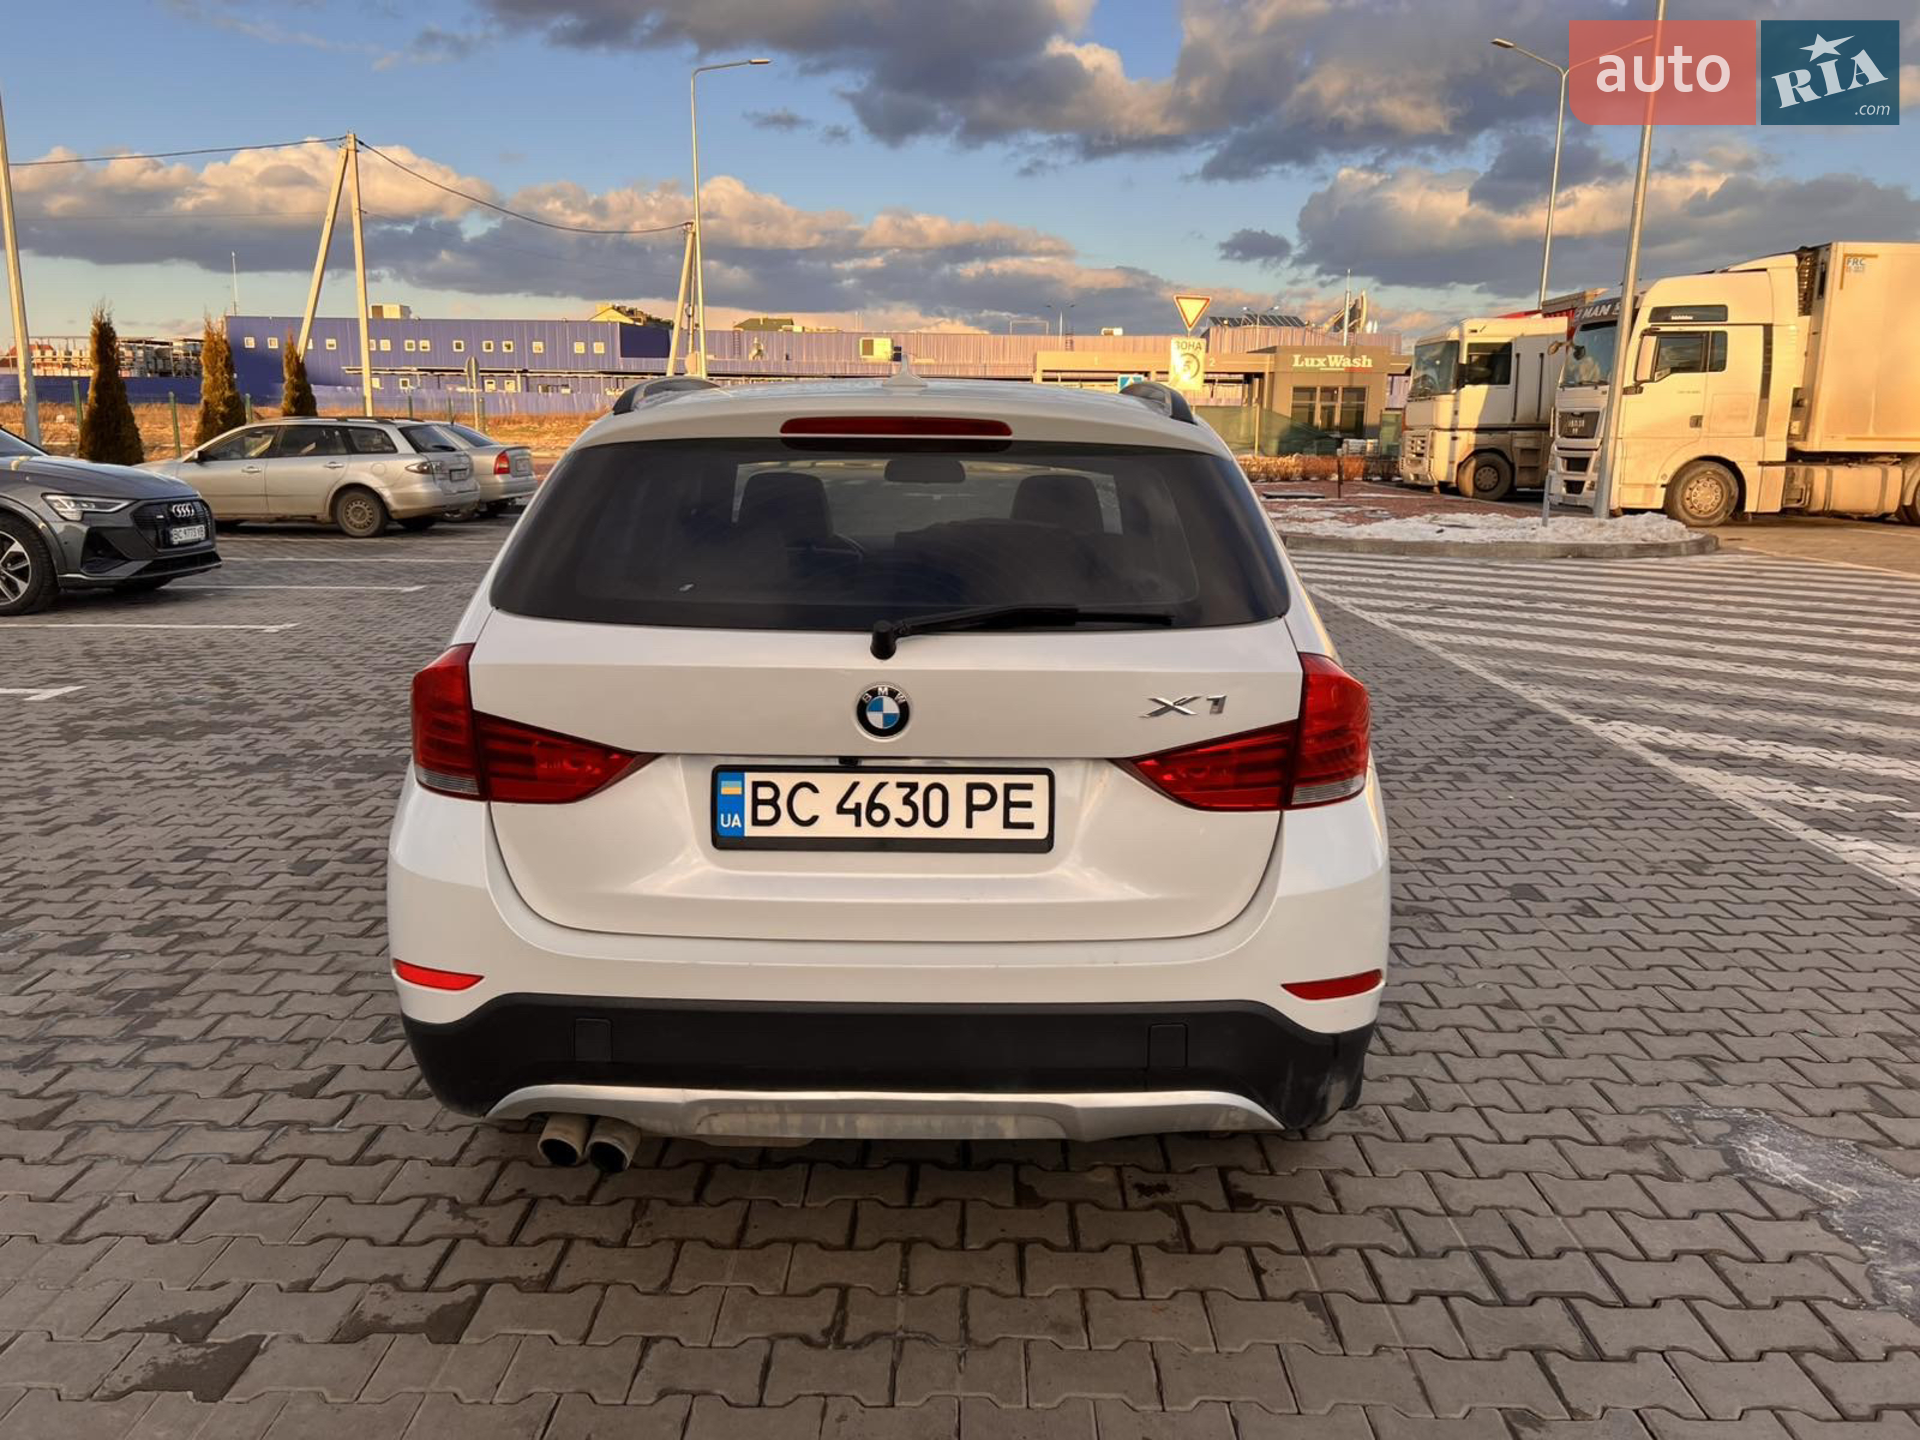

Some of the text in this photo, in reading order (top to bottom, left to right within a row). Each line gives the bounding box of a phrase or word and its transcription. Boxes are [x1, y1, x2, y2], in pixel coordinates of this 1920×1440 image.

[1582, 304, 1612, 319] MAN
[1292, 354, 1373, 368] LuxWash
[862, 686, 907, 704] BMW
[1140, 695, 1228, 718] X1
[751, 780, 1035, 830] BC 4630 PE
[720, 813, 742, 828] UA
